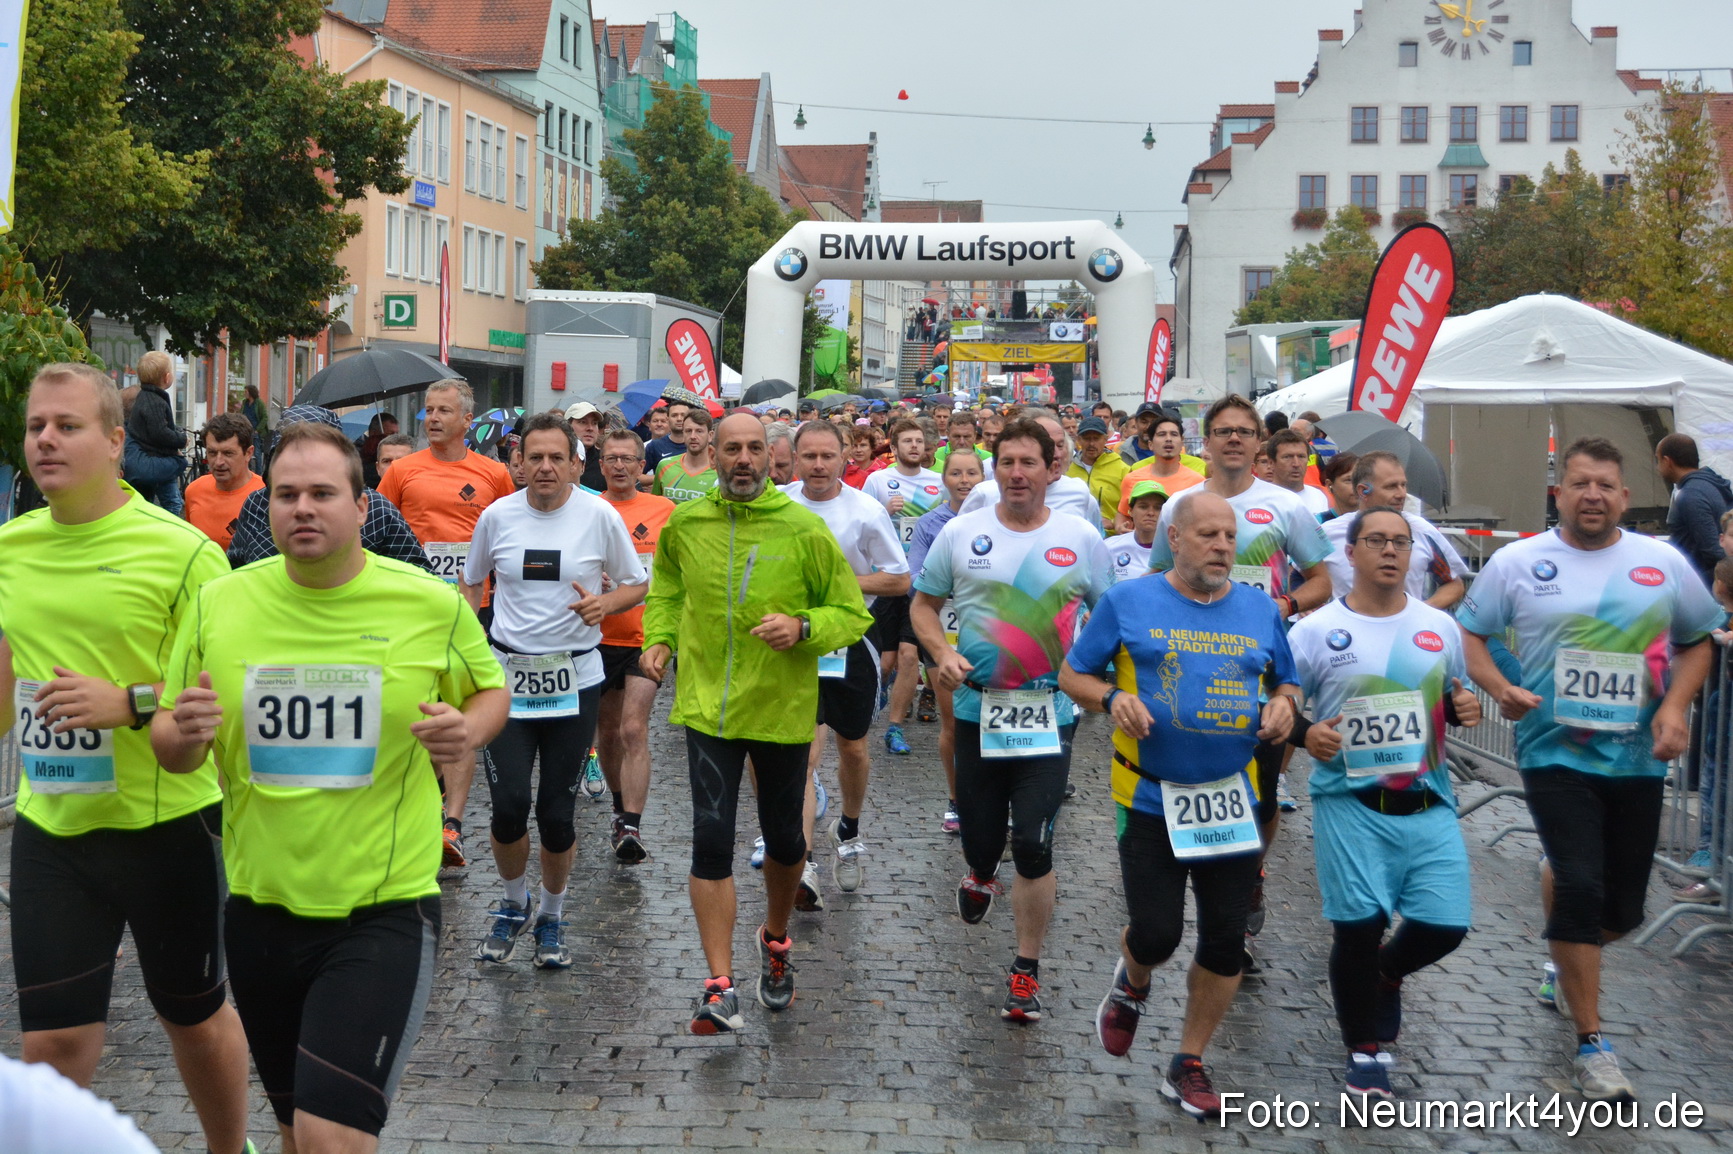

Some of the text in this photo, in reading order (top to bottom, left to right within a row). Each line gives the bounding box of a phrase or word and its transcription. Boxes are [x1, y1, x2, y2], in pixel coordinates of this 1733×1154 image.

[820, 234, 1075, 266] BMW Laufsport
[389, 299, 411, 322] D
[1358, 252, 1441, 418] REWE
[1003, 347, 1033, 358] ZIEL
[1049, 551, 1074, 562] Hervis
[1634, 571, 1661, 582] Hervis
[1534, 584, 1561, 592] PARTL
[1149, 628, 1258, 649] 10. NEUMARKTER
[1168, 639, 1245, 656] STADTLAUF
[1329, 652, 1357, 664] PARTL
[1331, 659, 1358, 669] Neumarkt
[304, 669, 370, 684] BOCK
[514, 668, 570, 694] 2550
[1564, 668, 1635, 701] 2044
[527, 700, 557, 709] Martin
[1373, 695, 1416, 708] BOCK
[258, 695, 363, 739] 3011
[988, 704, 1049, 728] 2424
[1581, 706, 1616, 719] Oskar
[1347, 711, 1422, 747] 2524
[1006, 735, 1033, 745] Franz
[485, 749, 498, 783] odlo
[1374, 752, 1403, 764] Marc
[35, 761, 75, 777] Manu
[1174, 788, 1245, 826] 2038
[1194, 828, 1236, 844] Norbert
